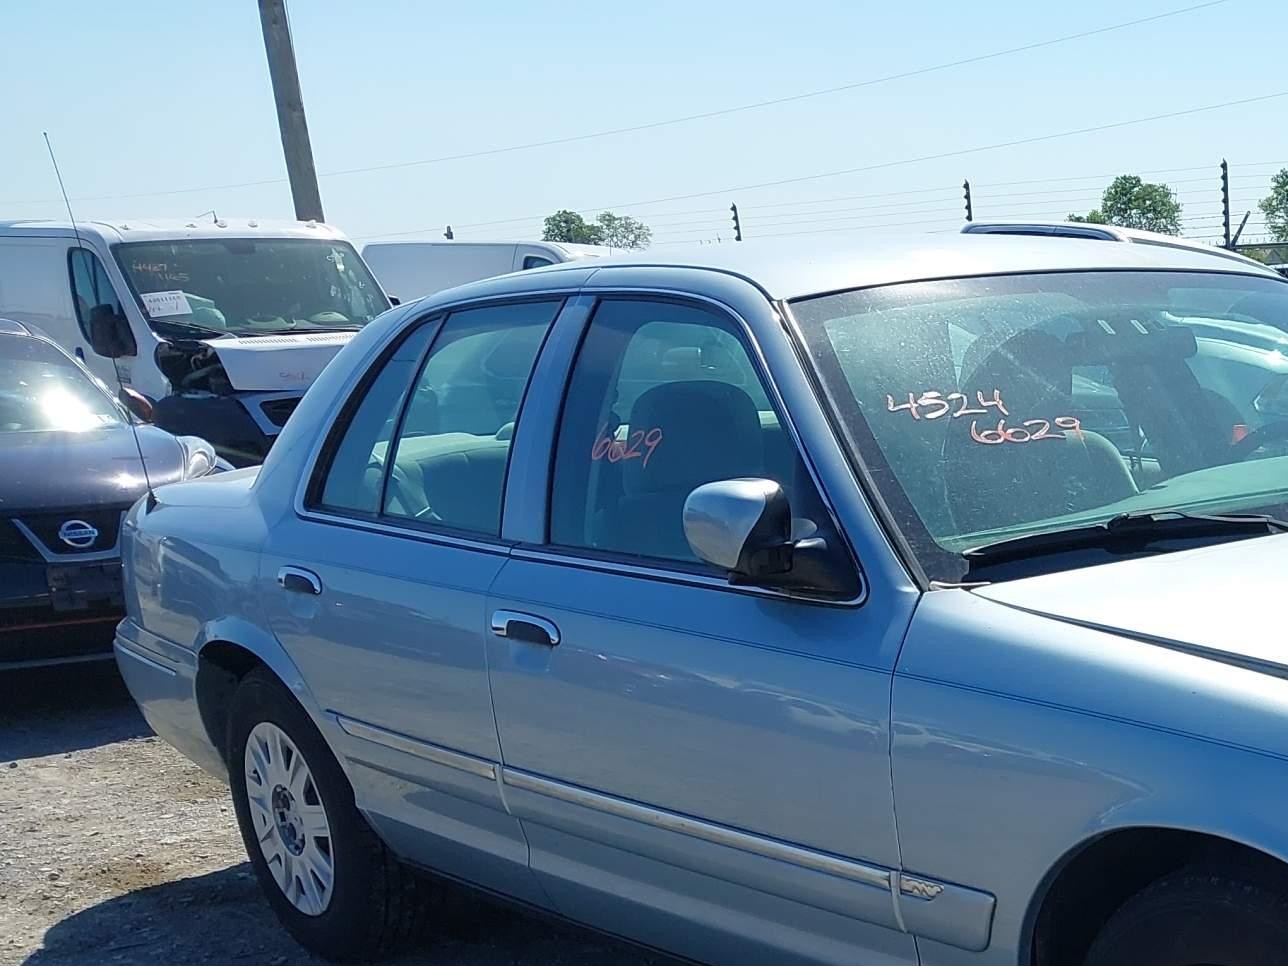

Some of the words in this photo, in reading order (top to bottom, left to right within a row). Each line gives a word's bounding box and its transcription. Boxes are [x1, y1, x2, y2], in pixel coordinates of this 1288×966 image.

[886, 389, 1010, 420] 4524
[591, 422, 663, 469] 6629
[971, 417, 1089, 449] 6629
